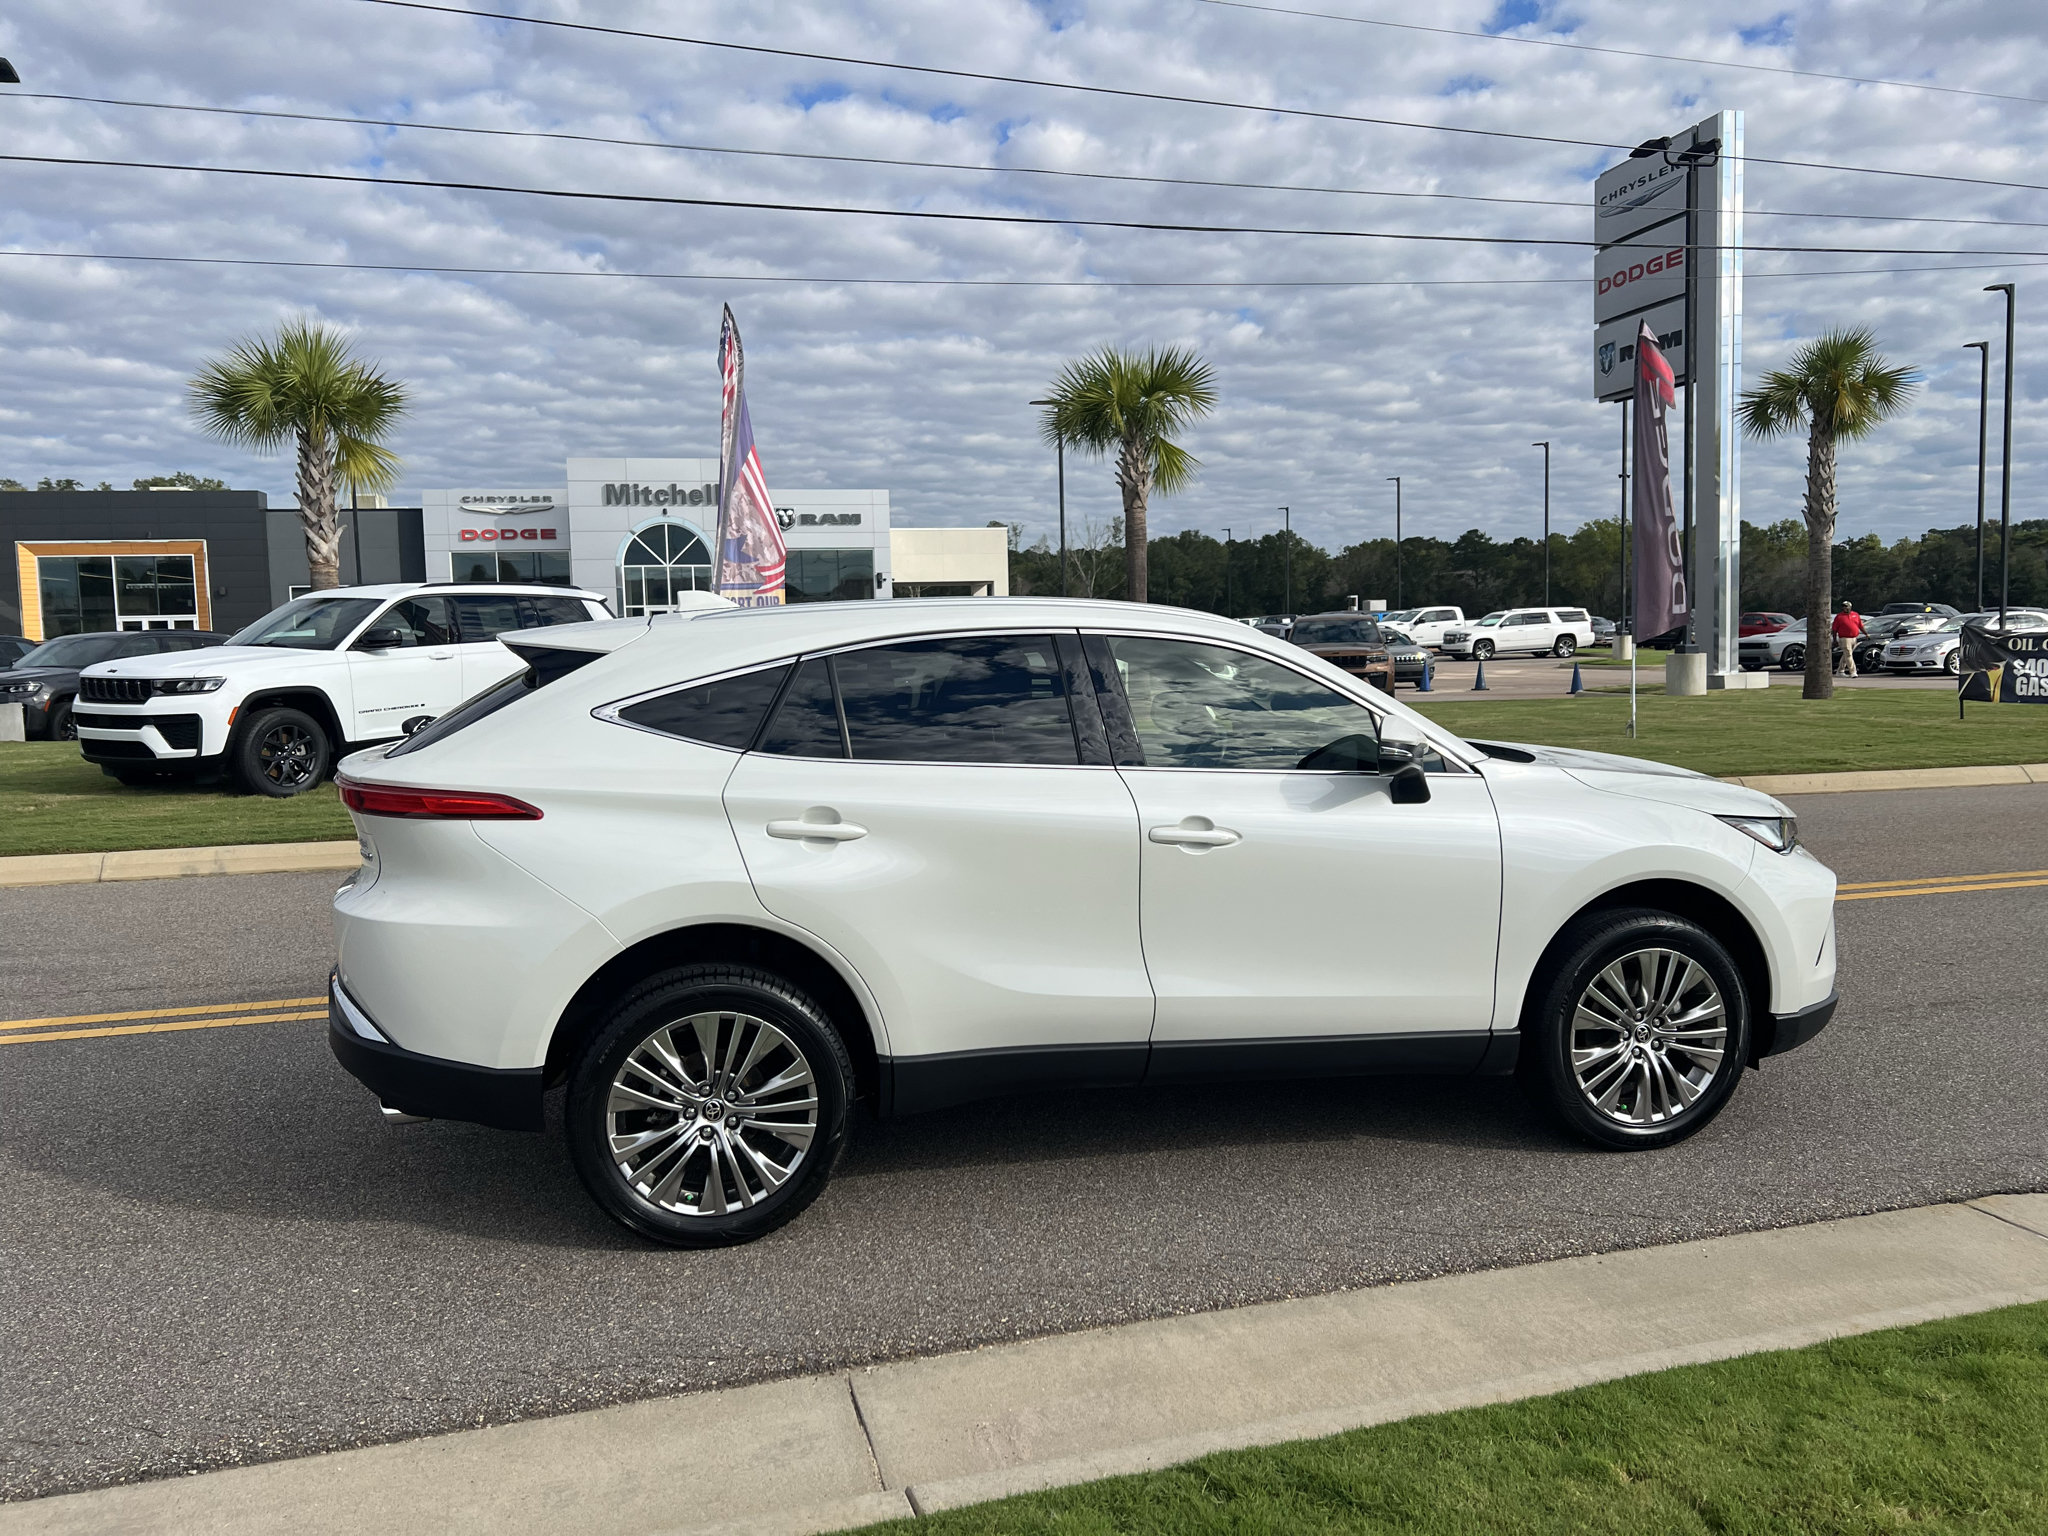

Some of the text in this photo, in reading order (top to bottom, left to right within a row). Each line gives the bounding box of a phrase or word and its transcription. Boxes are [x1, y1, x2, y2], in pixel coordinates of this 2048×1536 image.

[1598, 248, 1684, 295] DODGE
[1620, 329, 1682, 363] RM
[461, 496, 553, 504] CHRYSLER
[602, 484, 720, 507] Mitchell
[798, 513, 862, 526] RAM
[460, 528, 557, 541] DODGE
[2008, 637, 2039, 651] OIL
[2013, 658, 2048, 678] $40
[2015, 676, 2048, 697] GAS
